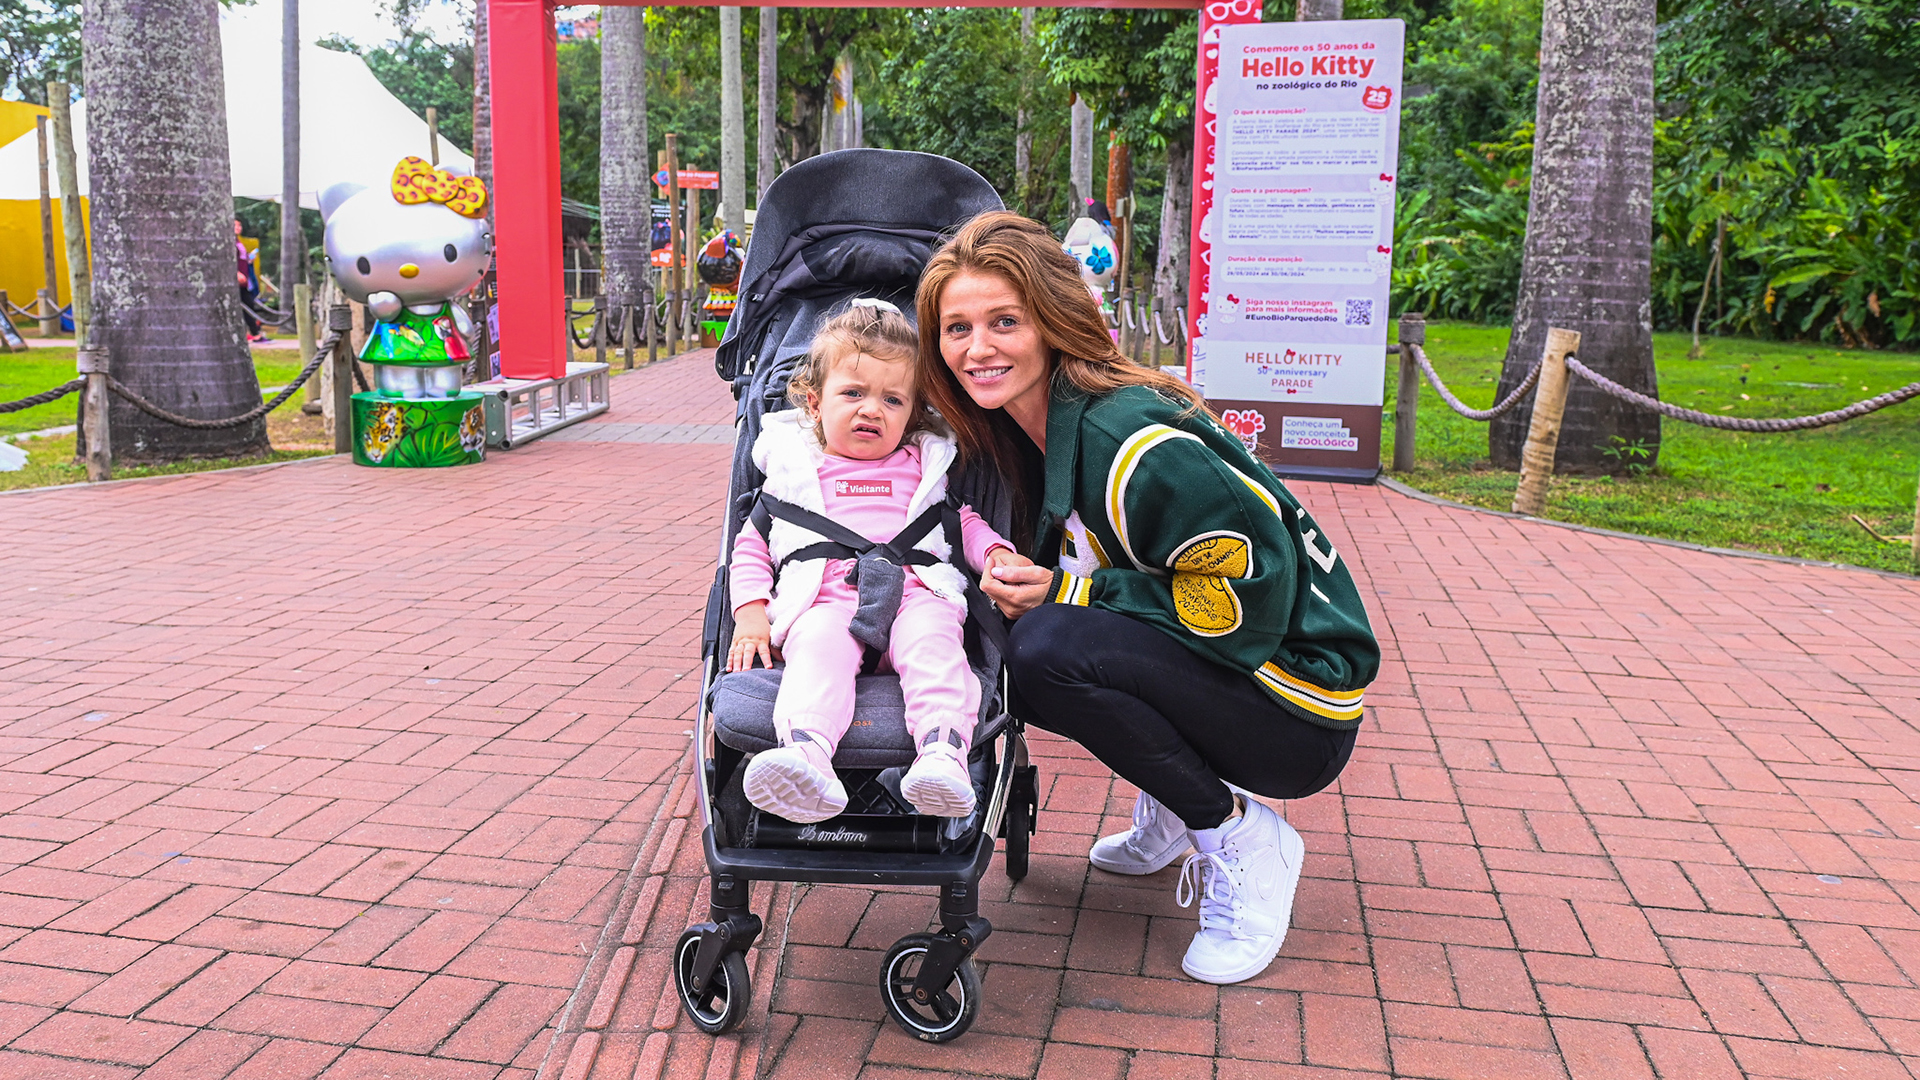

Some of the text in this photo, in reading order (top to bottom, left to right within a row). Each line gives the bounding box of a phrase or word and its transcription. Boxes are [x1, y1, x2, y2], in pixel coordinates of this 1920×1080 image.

[1242, 55, 1374, 78] Hello Kitty
[1272, 81, 1321, 90] zoológico
[1367, 90, 1387, 103] 25
[1246, 352, 1342, 366] HELLO KITTY
[1274, 368, 1327, 378] anniversary
[1272, 378, 1313, 388] PARADE
[1285, 419, 1323, 428] Conheça
[1298, 438, 1355, 447] ZOOLÓGICO
[850, 485, 890, 493] Visitante
[1208, 549, 1235, 568] CHAMPS
[1184, 576, 1215, 612] REGIONAL
[1176, 581, 1217, 621] CHAMPIONS
[1178, 598, 1199, 616] 2022
